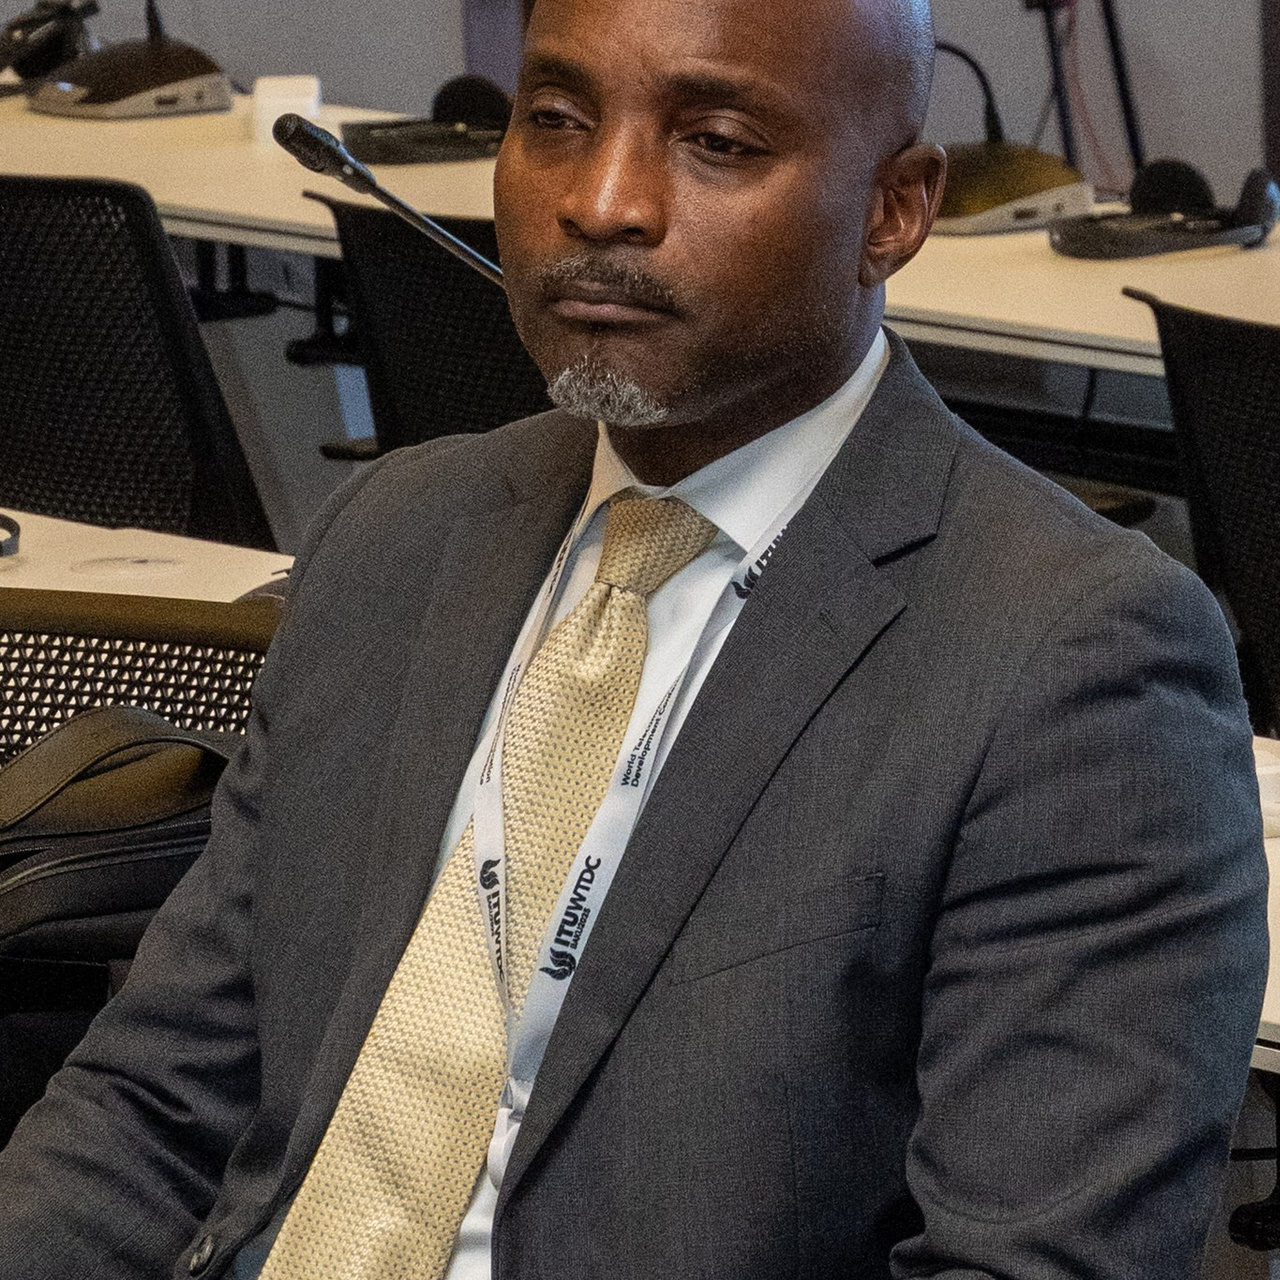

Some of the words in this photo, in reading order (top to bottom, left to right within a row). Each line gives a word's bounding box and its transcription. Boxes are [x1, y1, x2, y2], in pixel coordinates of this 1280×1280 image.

[621, 753, 637, 786] World
[631, 718, 661, 788] Development
[554, 855, 601, 948] ITUWTDC
[570, 908, 591, 950] BAKU2025
